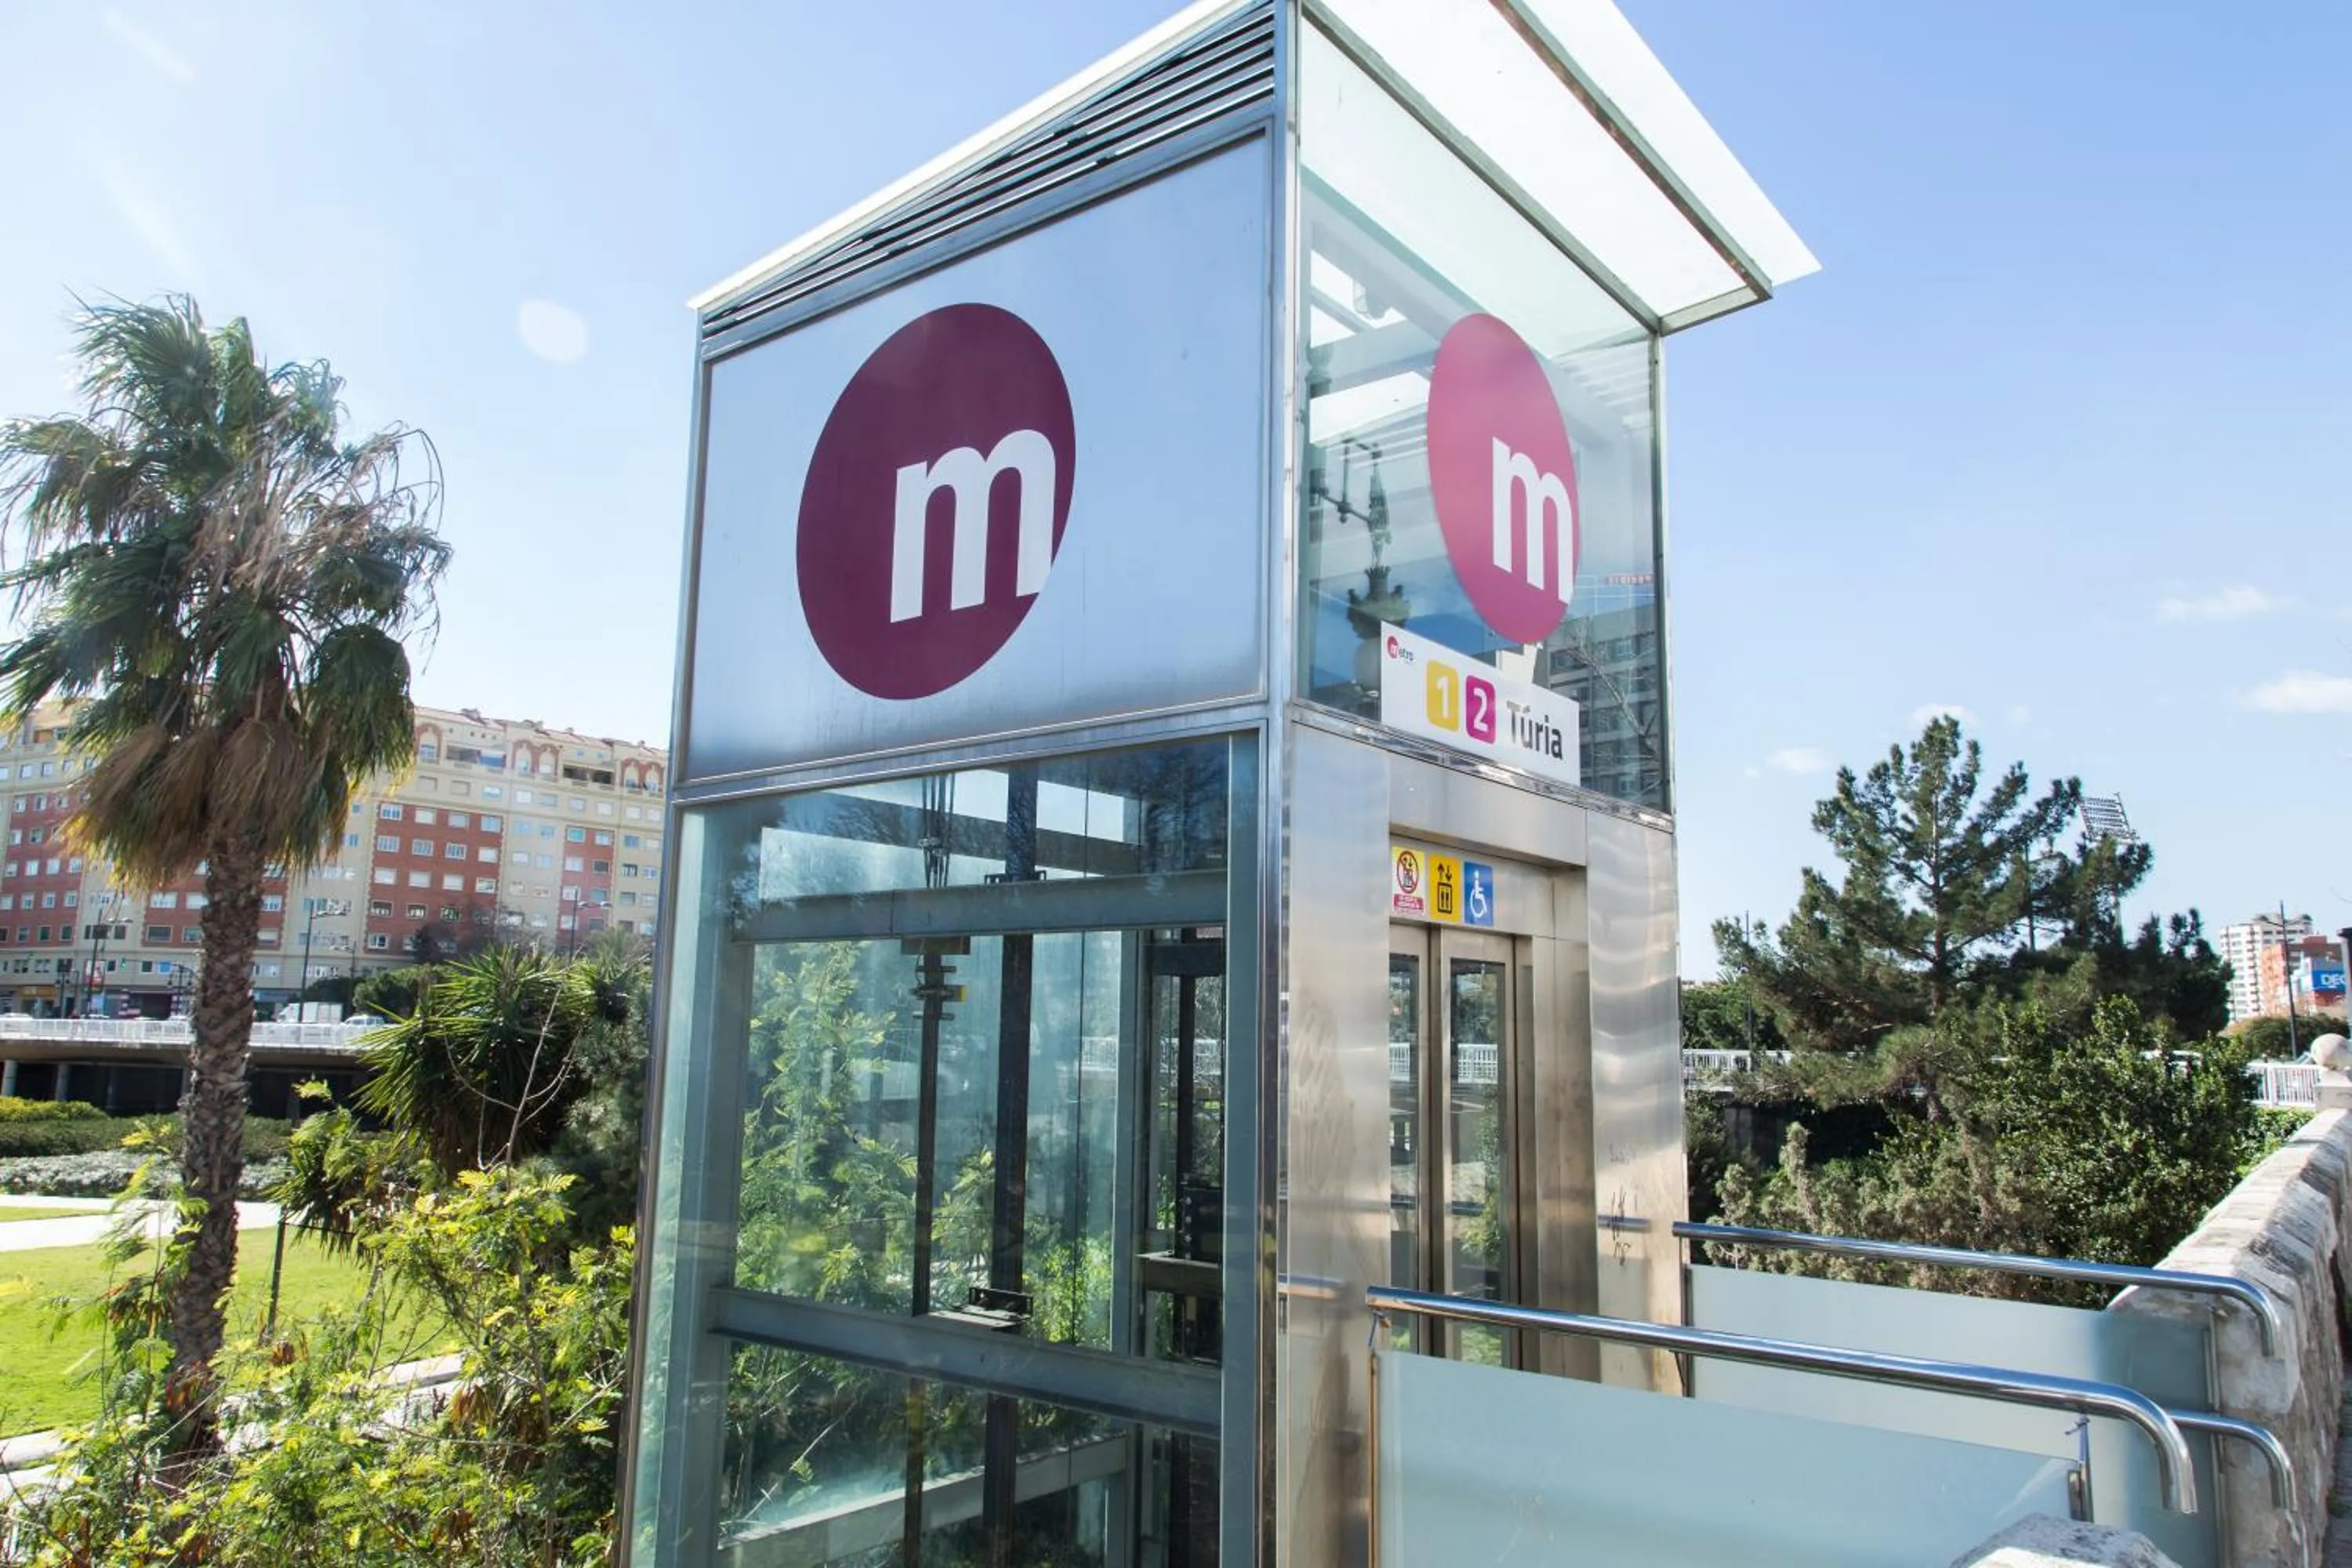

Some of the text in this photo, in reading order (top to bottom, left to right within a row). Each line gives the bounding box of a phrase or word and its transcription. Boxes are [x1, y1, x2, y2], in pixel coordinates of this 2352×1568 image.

[890, 429, 1056, 623] m
[1493, 436, 1574, 606] m
[1436, 677, 1563, 760] 1 2 Túria
